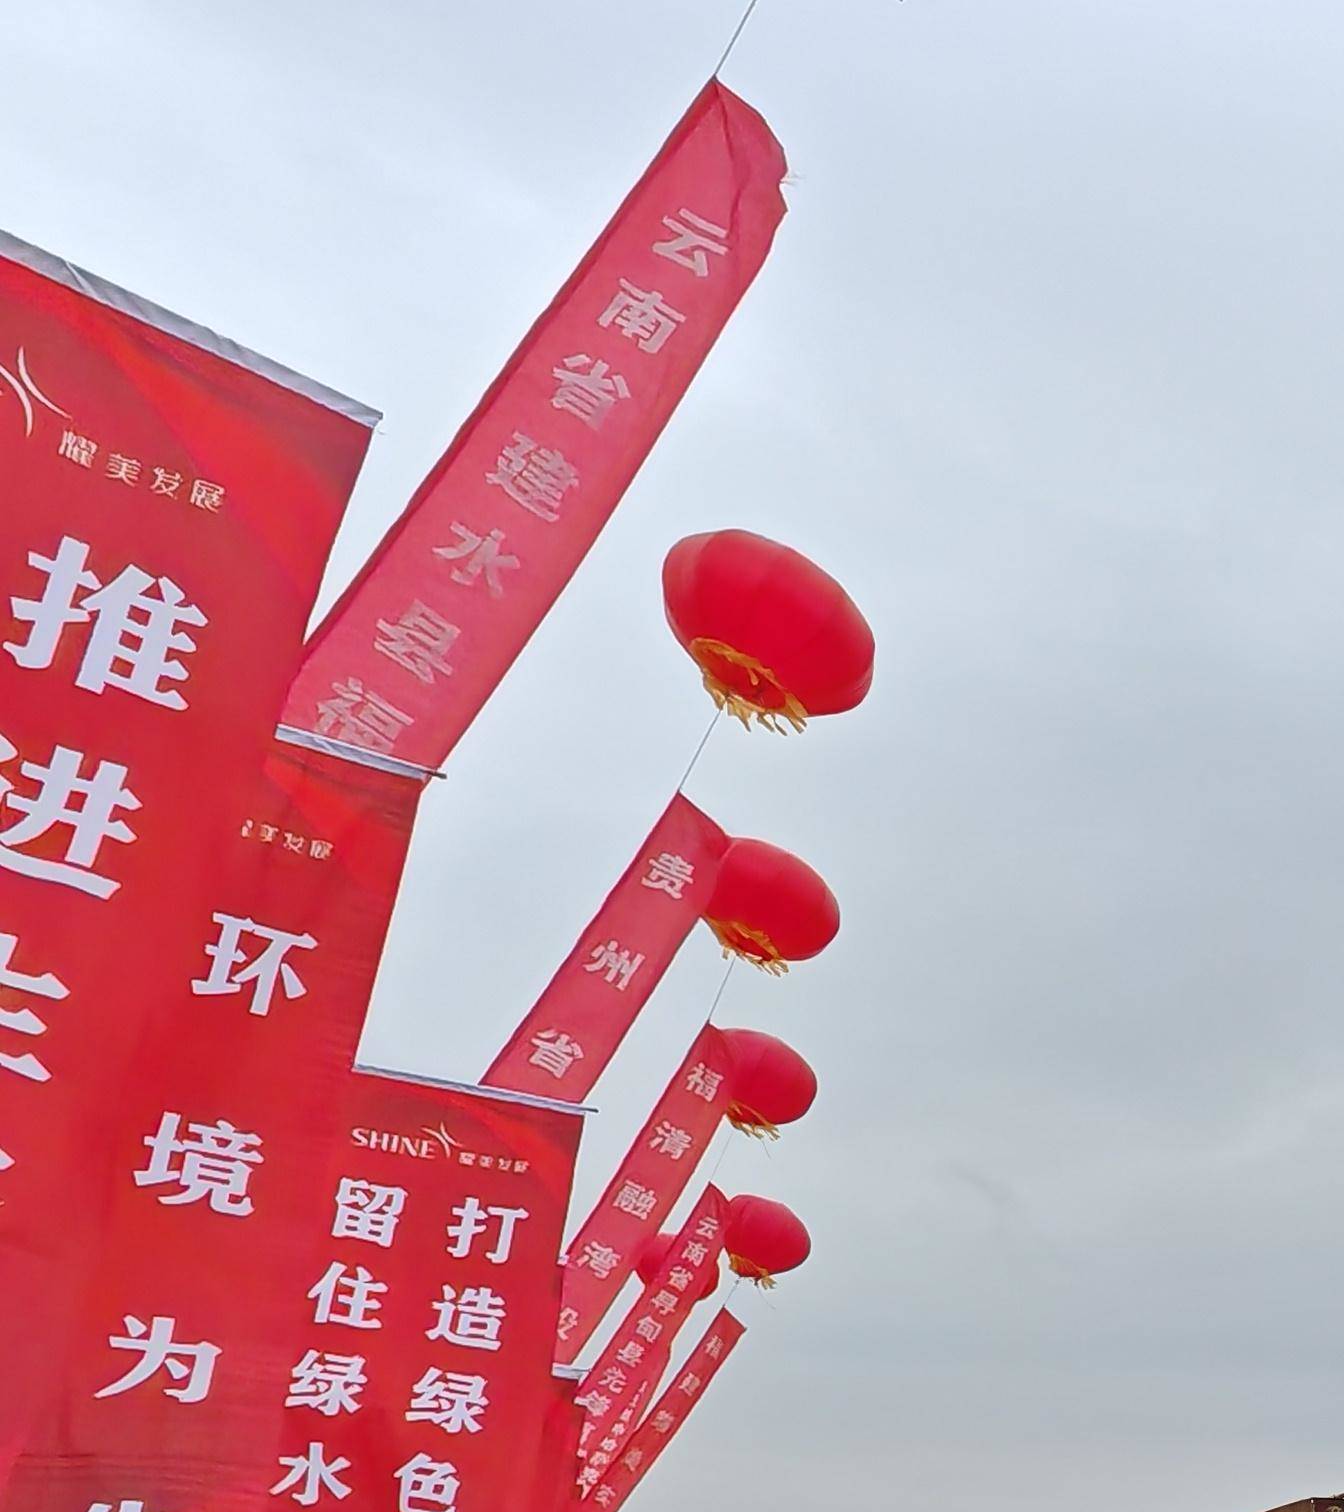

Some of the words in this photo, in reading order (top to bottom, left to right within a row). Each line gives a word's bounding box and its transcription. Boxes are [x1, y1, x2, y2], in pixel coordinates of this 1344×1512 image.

[58, 430, 225, 513] 耀美发展
[315, 207, 730, 756] 云南省建水县福
[528, 851, 696, 1080] 贵州省
[351, 1127, 438, 1160] SHINE
